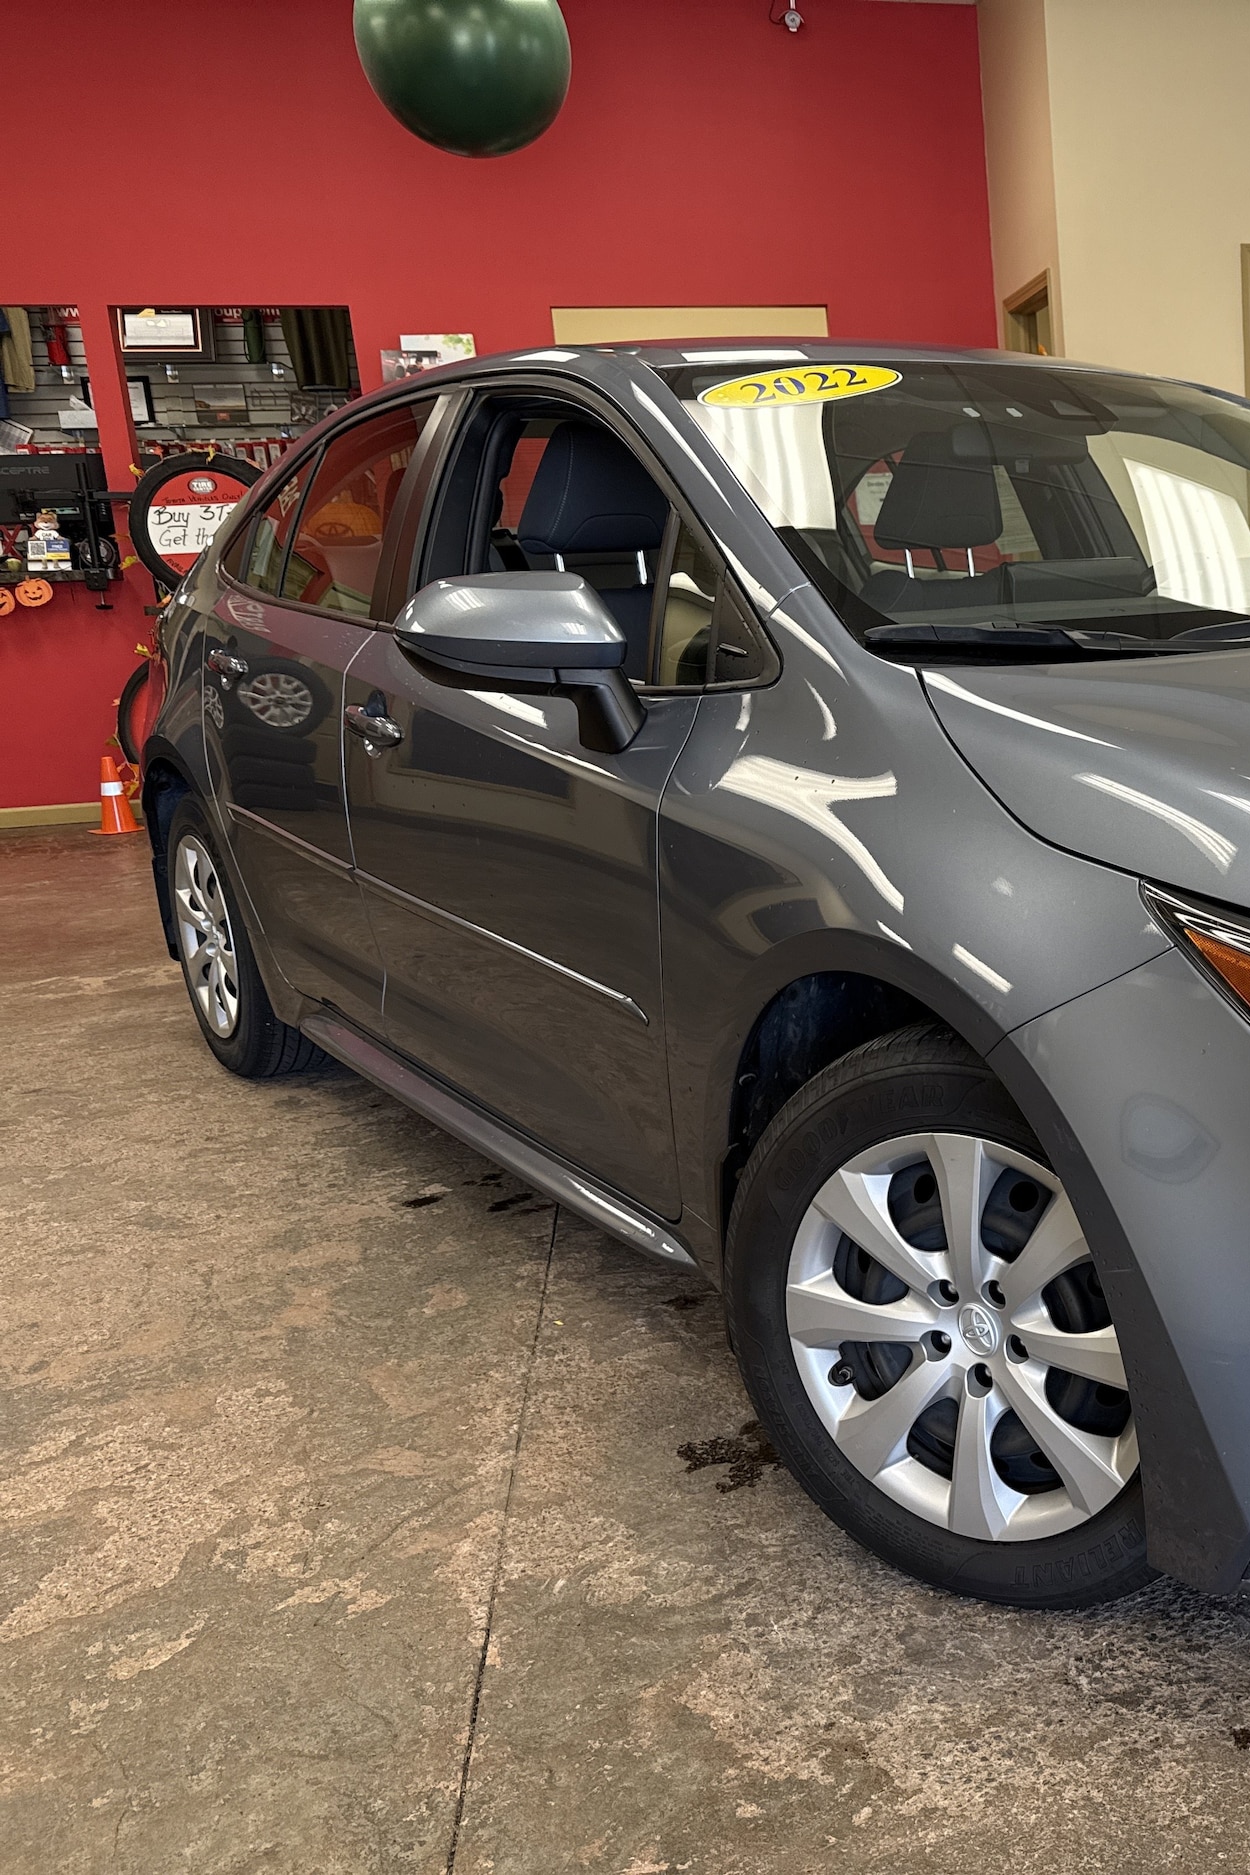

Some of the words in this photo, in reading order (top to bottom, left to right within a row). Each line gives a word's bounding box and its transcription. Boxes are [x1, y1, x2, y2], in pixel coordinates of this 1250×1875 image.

[739, 367, 868, 404] 2022
[151, 505, 190, 528] Buy
[199, 505, 215, 521] 3
[158, 528, 189, 548] Get
[774, 1085, 945, 1191] GOODYEAR
[1009, 1518, 1144, 1589] RELIANT
